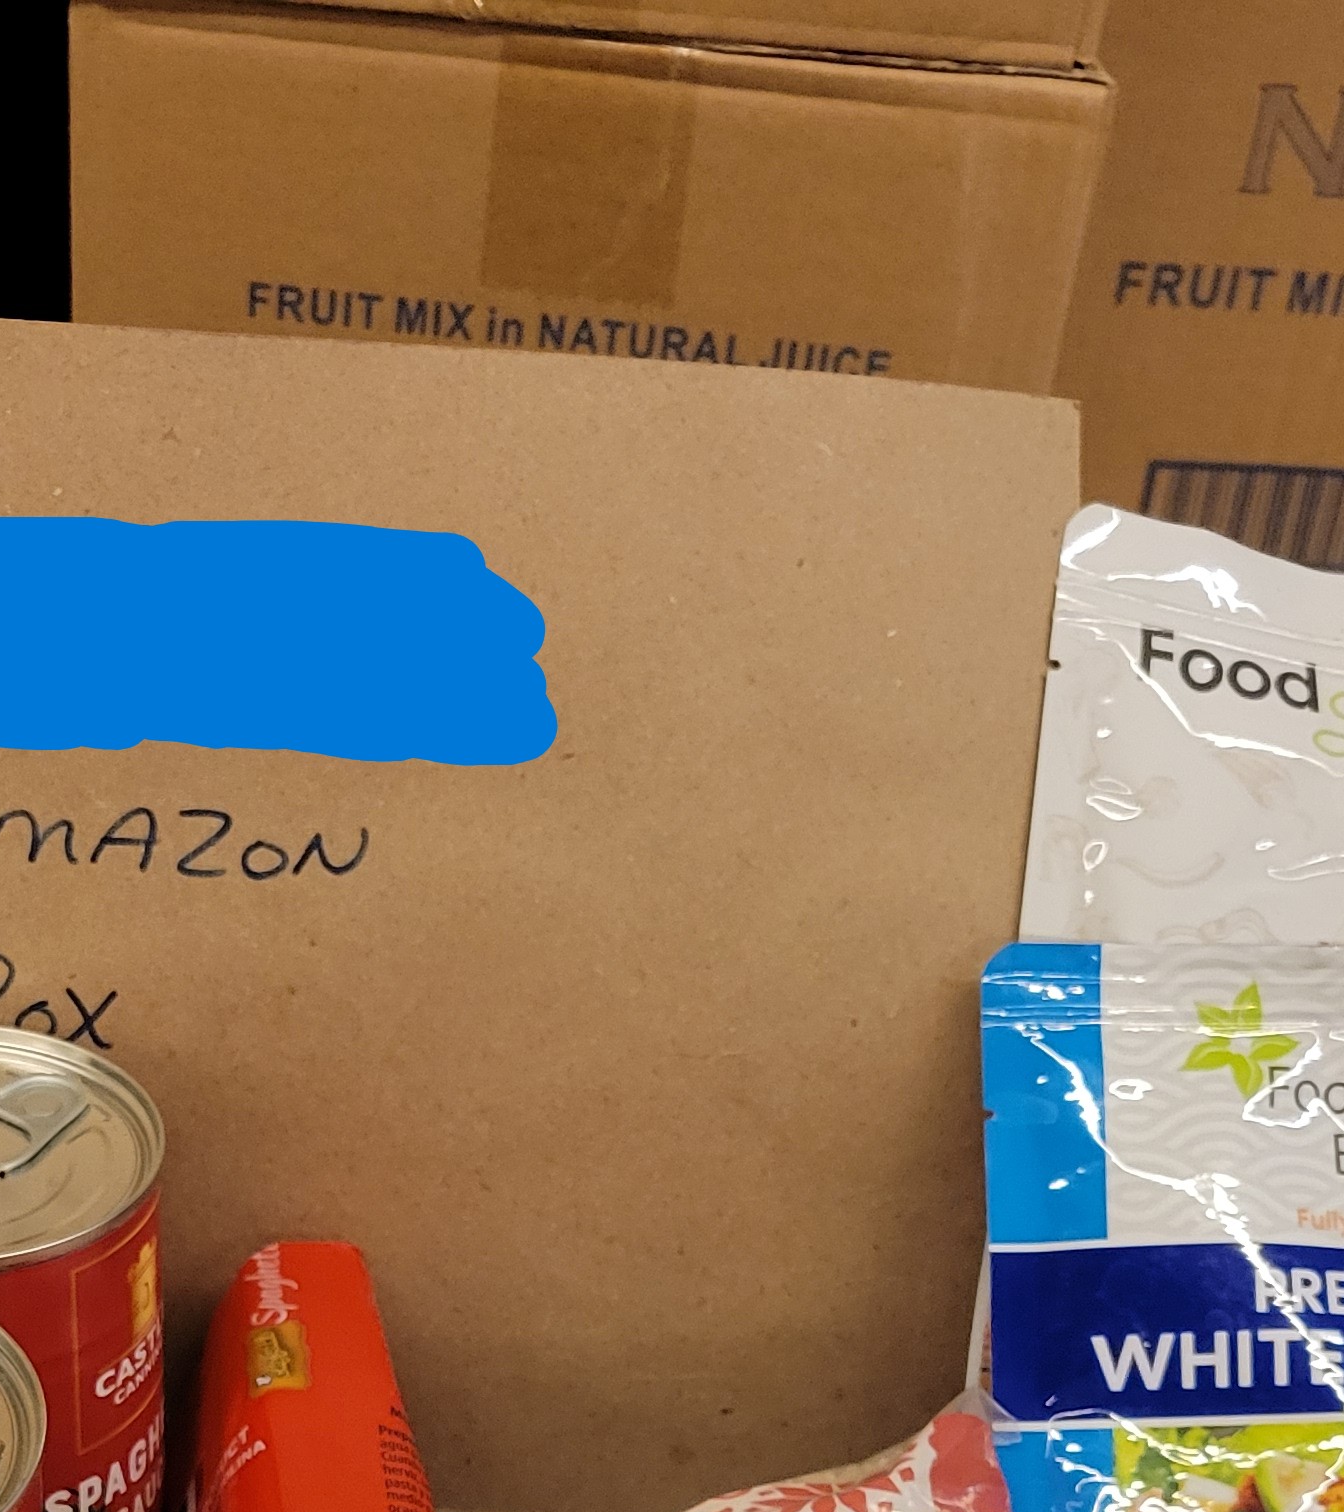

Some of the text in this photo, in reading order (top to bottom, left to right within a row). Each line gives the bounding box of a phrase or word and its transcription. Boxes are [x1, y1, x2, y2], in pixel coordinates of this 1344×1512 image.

[1114, 261, 1277, 309] FRUIT
[248, 280, 383, 331] FRUIT
[395, 296, 475, 341] MIX
[487, 306, 524, 348] in
[538, 313, 743, 367] NATURAL
[1138, 627, 1320, 713] Food
[1092, 1331, 1344, 1394] WHITE
